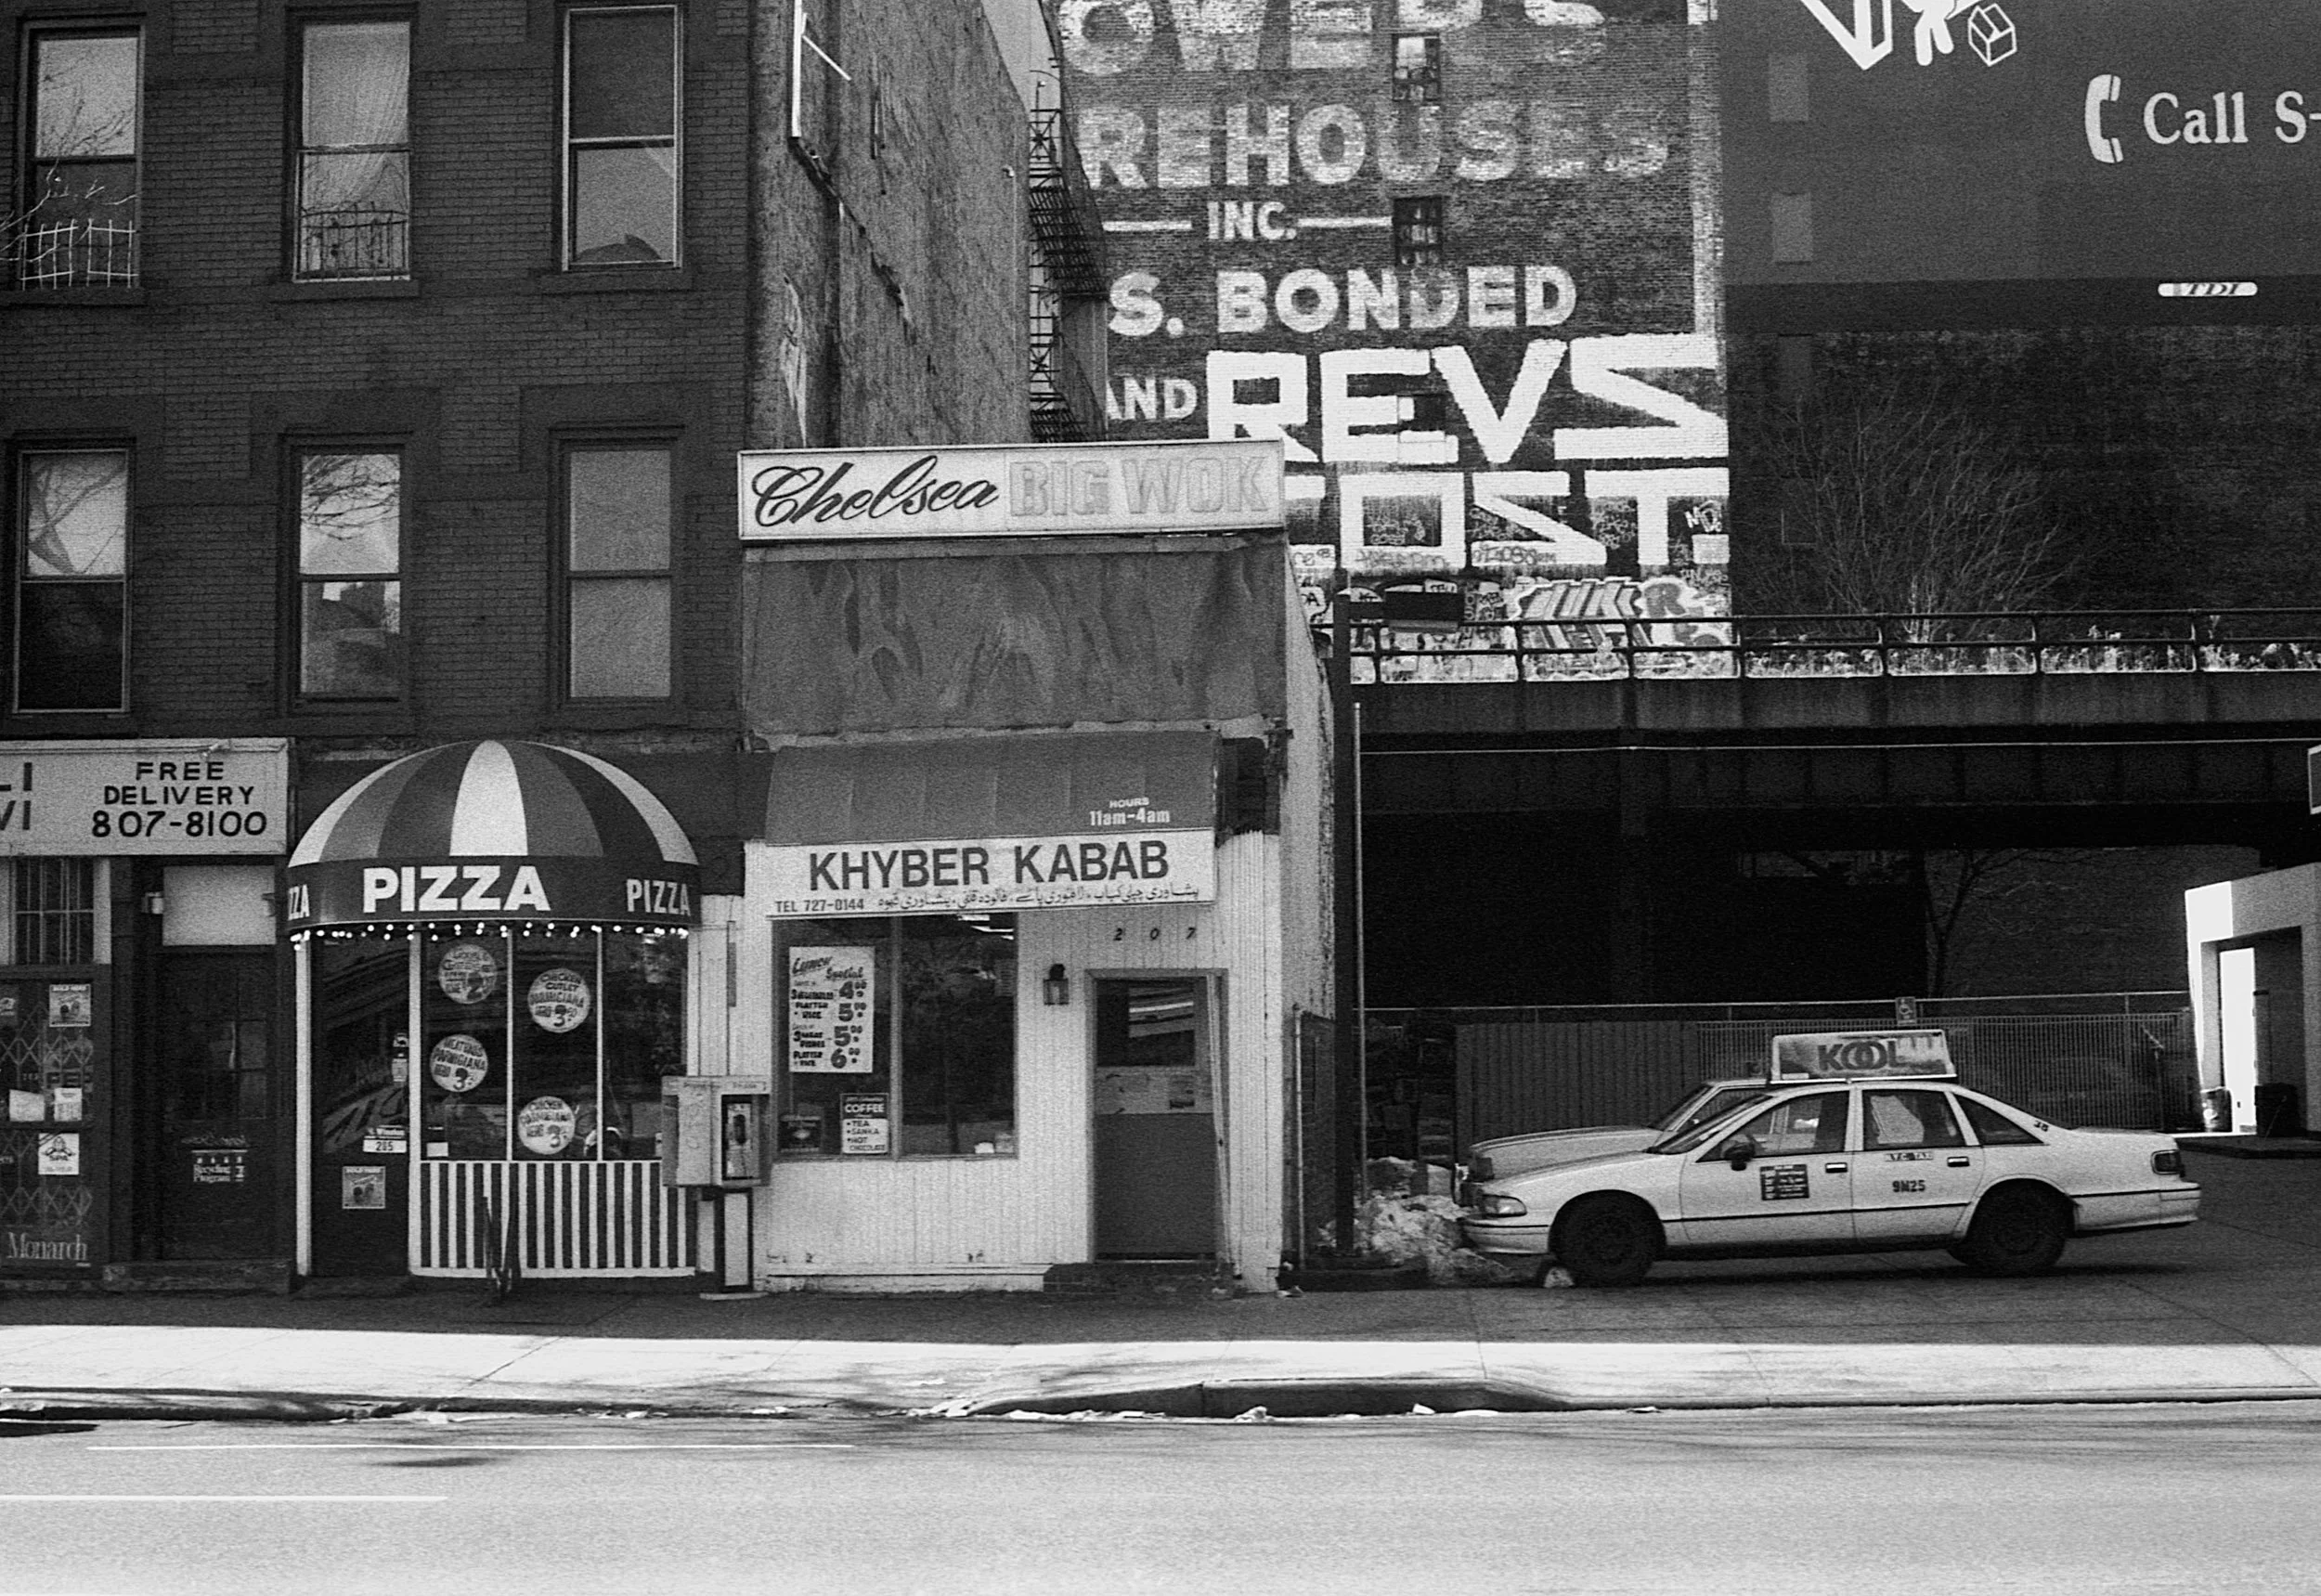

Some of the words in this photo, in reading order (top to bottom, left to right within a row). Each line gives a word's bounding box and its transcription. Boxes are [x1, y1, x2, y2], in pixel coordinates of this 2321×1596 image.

[2144, 92, 2249, 145] Call
[1208, 199, 1296, 241] INC.
[1109, 273, 1184, 337] S.
[1217, 265, 1575, 335] BONDED
[1207, 332, 1730, 463] REVS
[751, 455, 998, 526] Chelsea
[1009, 460, 1109, 516] BIG
[1122, 455, 1269, 514] WOK
[136, 761, 225, 781] FREE
[104, 785, 255, 806] DELIVERY
[1109, 797, 1150, 809] HOURS
[92, 810, 267, 838] 807-8100
[1089, 807, 1171, 826] 11am-4am
[810, 846, 991, 891] KHYBER
[1014, 839, 1170, 883] KABAB
[362, 865, 551, 914] PIZZA
[627, 877, 692, 918] PIZZA
[775, 900, 799, 914] TEL
[805, 898, 864, 913] 727-0144
[1817, 1040, 1904, 1071] KOOL
[845, 1104, 885, 1113] COFFEE
[6, 1231, 88, 1261] Monarch
